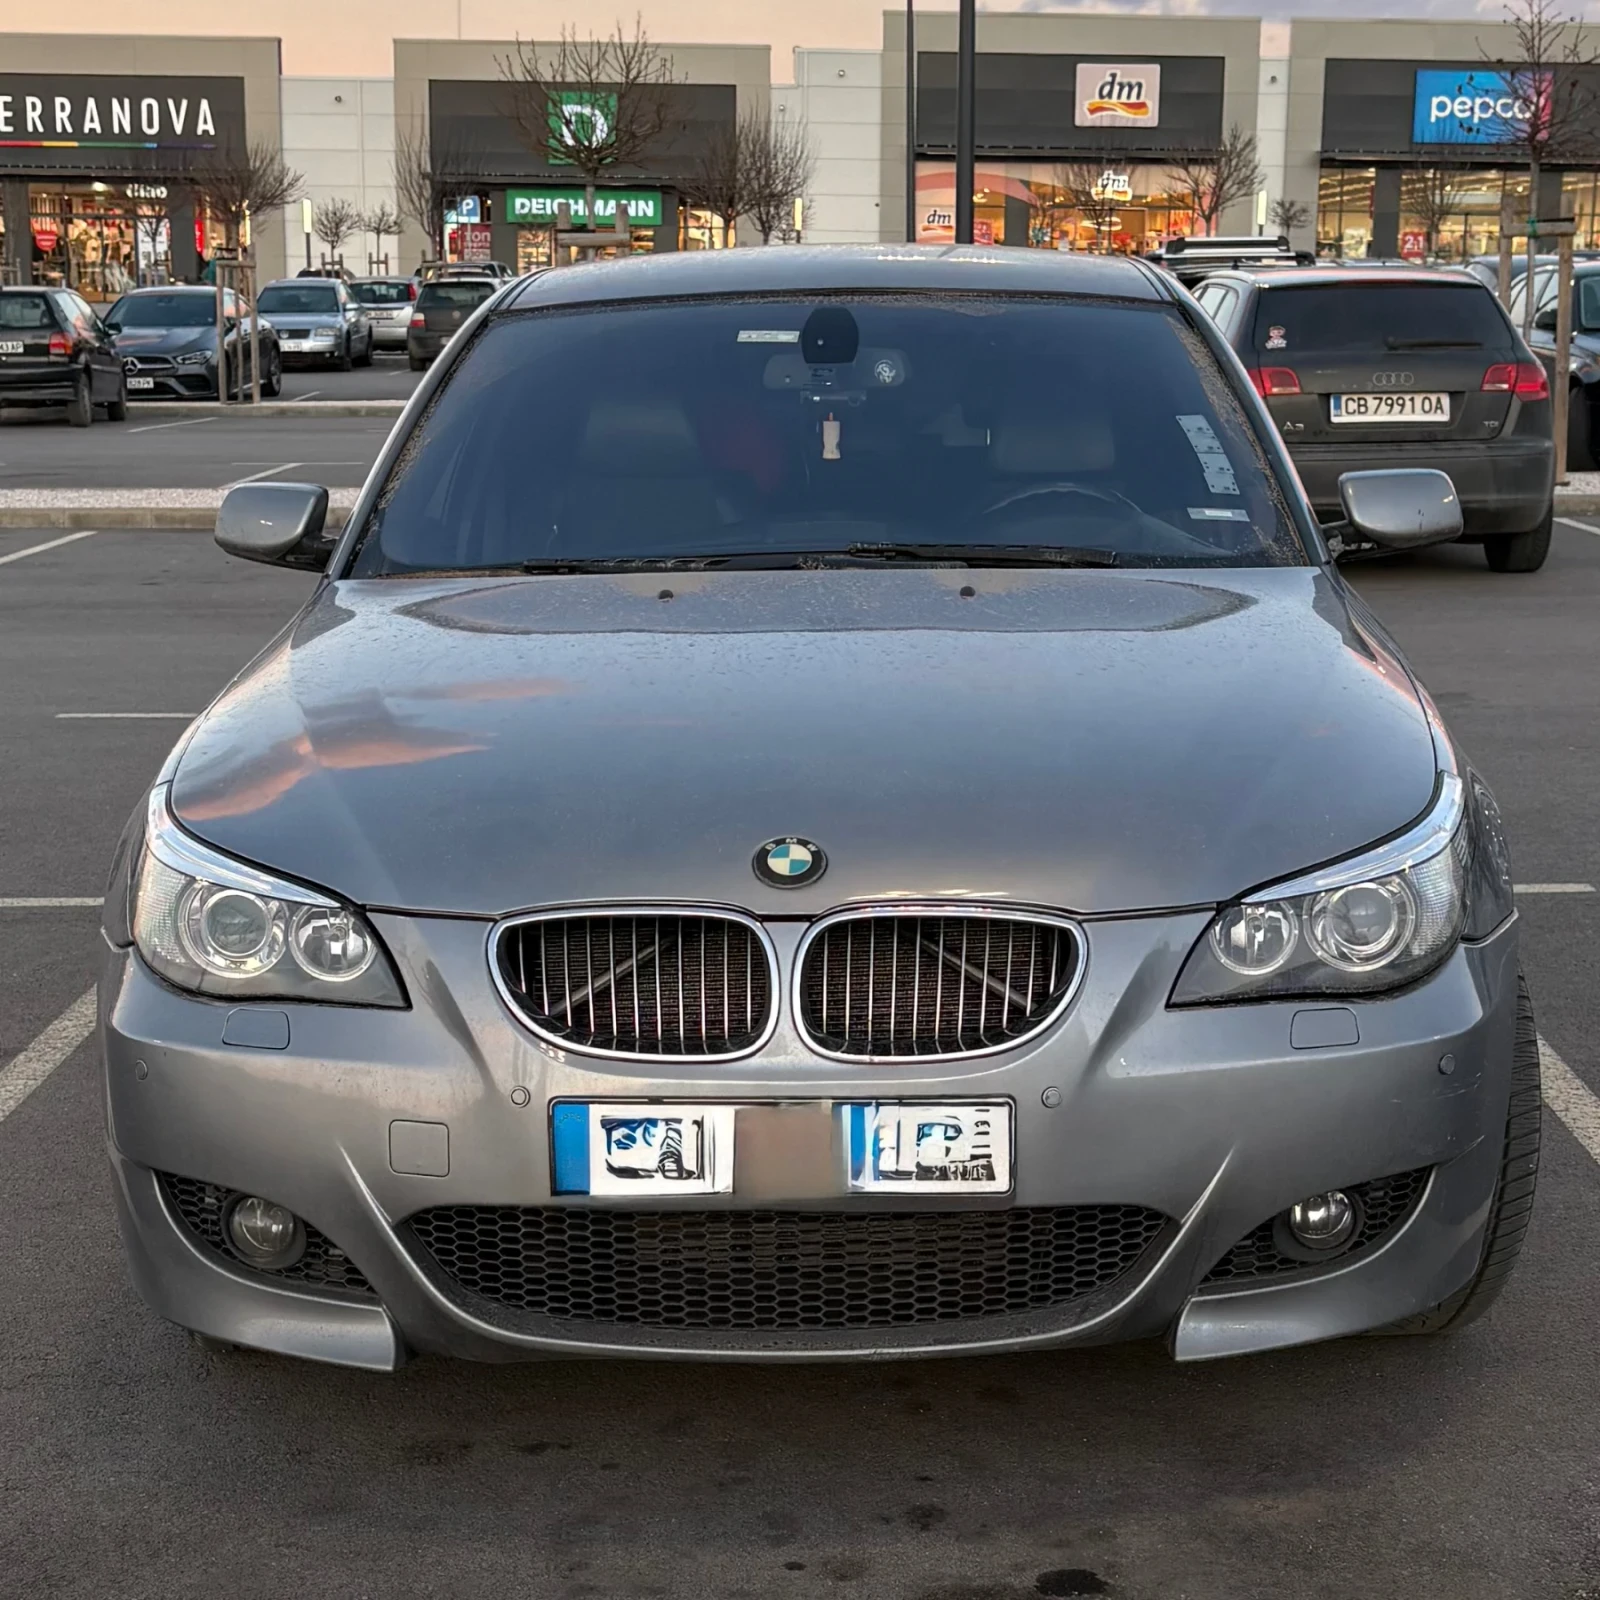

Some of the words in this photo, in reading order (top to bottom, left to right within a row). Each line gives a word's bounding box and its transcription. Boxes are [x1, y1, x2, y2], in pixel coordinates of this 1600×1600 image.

[1098, 72, 1143, 100] dm
[0, 95, 216, 136] ERRANOVA
[1430, 95, 1536, 123] pepco
[1101, 172, 1127, 188] dm
[462, 199, 474, 215] P
[927, 209, 951, 224] dm
[1345, 397, 1368, 414] CB
[1372, 396, 1415, 414] 7991
[764, 838, 819, 852] BMW
